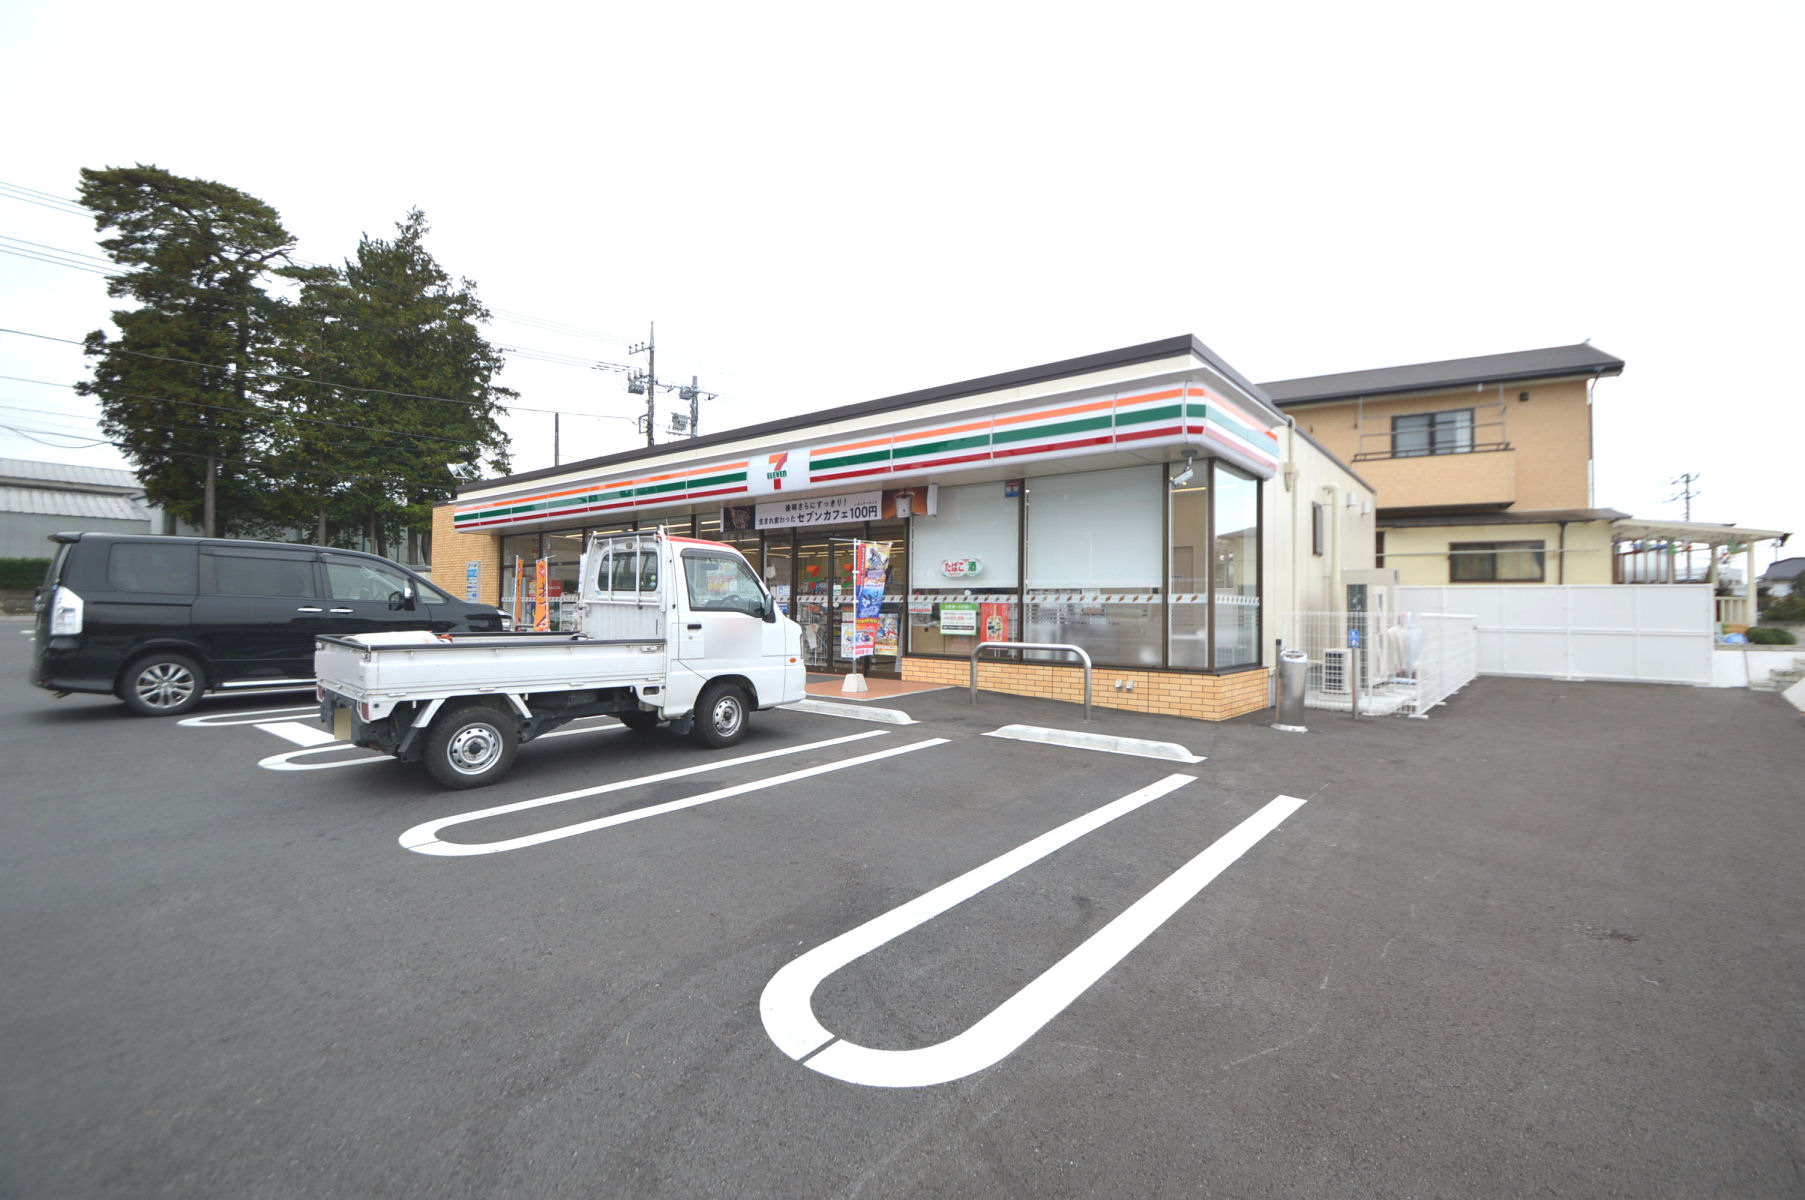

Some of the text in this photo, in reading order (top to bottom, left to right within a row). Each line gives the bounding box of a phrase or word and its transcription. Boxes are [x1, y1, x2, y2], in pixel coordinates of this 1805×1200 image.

[768, 451, 788, 490] 7
[945, 561, 976, 572] たばこ 酒
